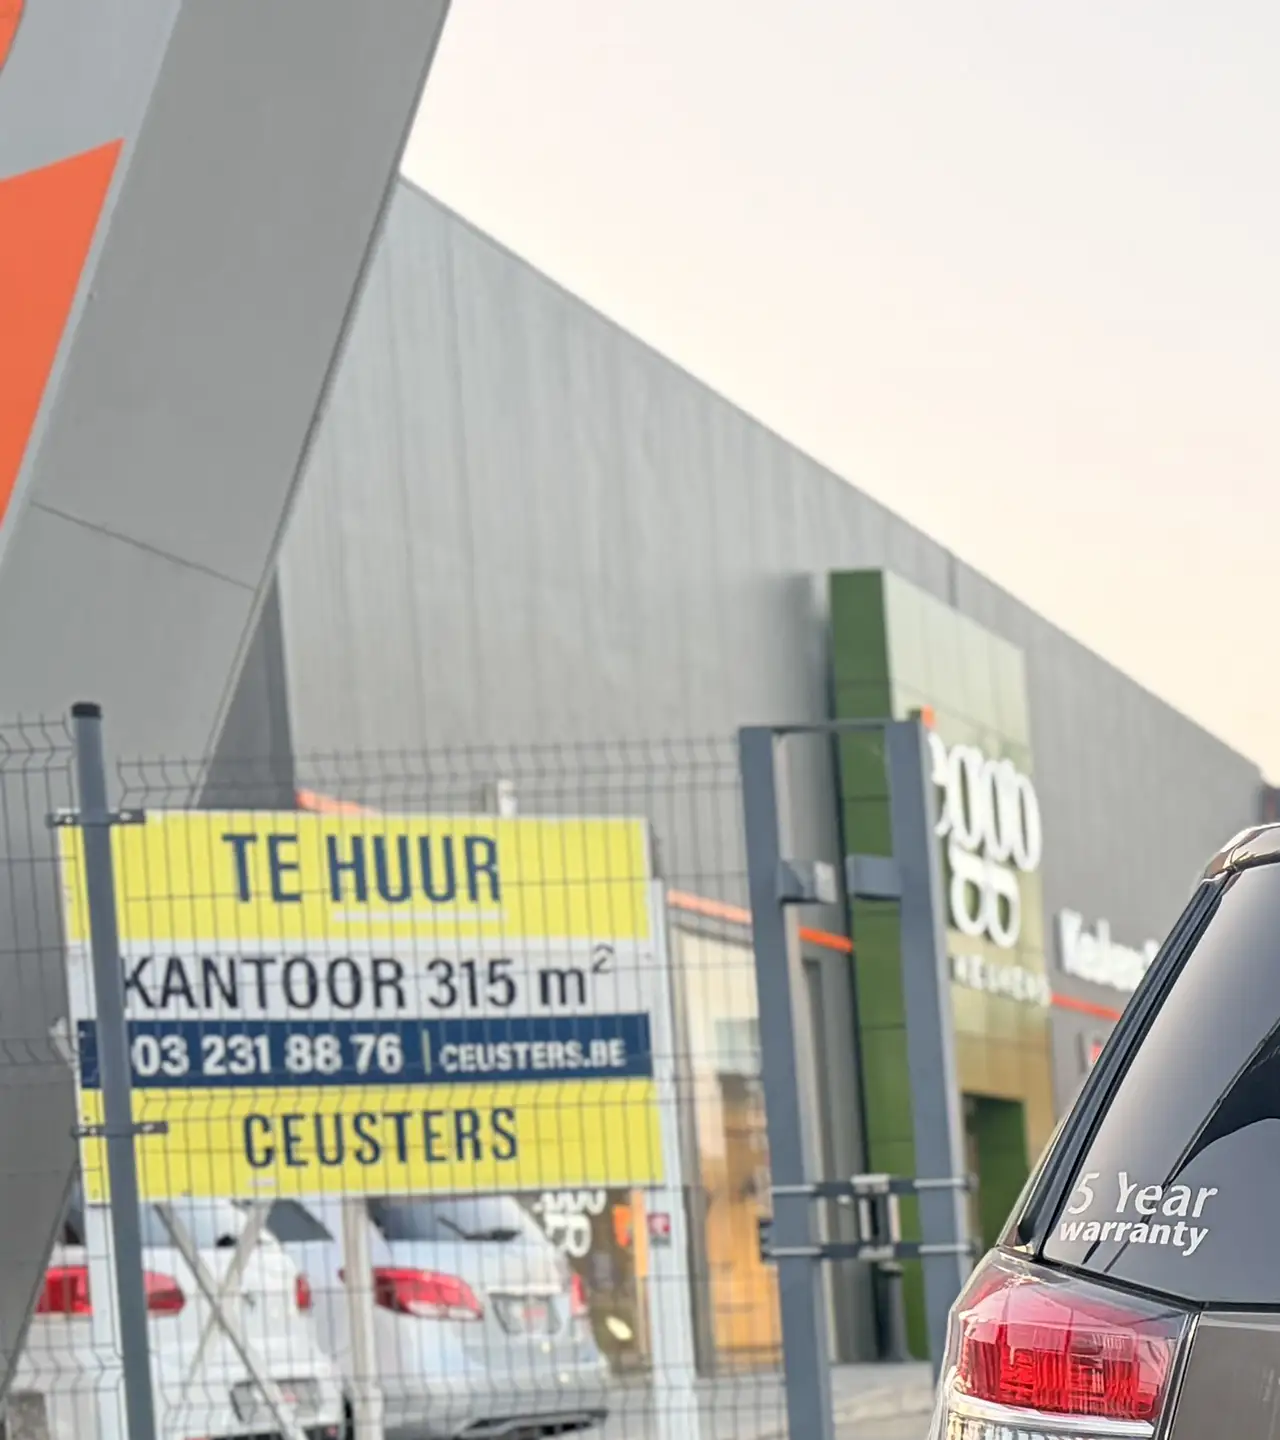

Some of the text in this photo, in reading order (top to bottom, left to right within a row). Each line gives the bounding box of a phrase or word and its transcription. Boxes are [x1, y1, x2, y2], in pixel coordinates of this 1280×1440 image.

[221, 833, 502, 904] TE HUUR
[123, 956, 407, 1009] KANTOOR
[426, 957, 518, 1009] 315
[131, 1032, 627, 1077] 03 231 88 76 CEUSTERS.BE
[242, 1106, 519, 1169] CEUSTERS
[1067, 1171, 1220, 1218] 5 Year
[1059, 1220, 1210, 1257] warranty
